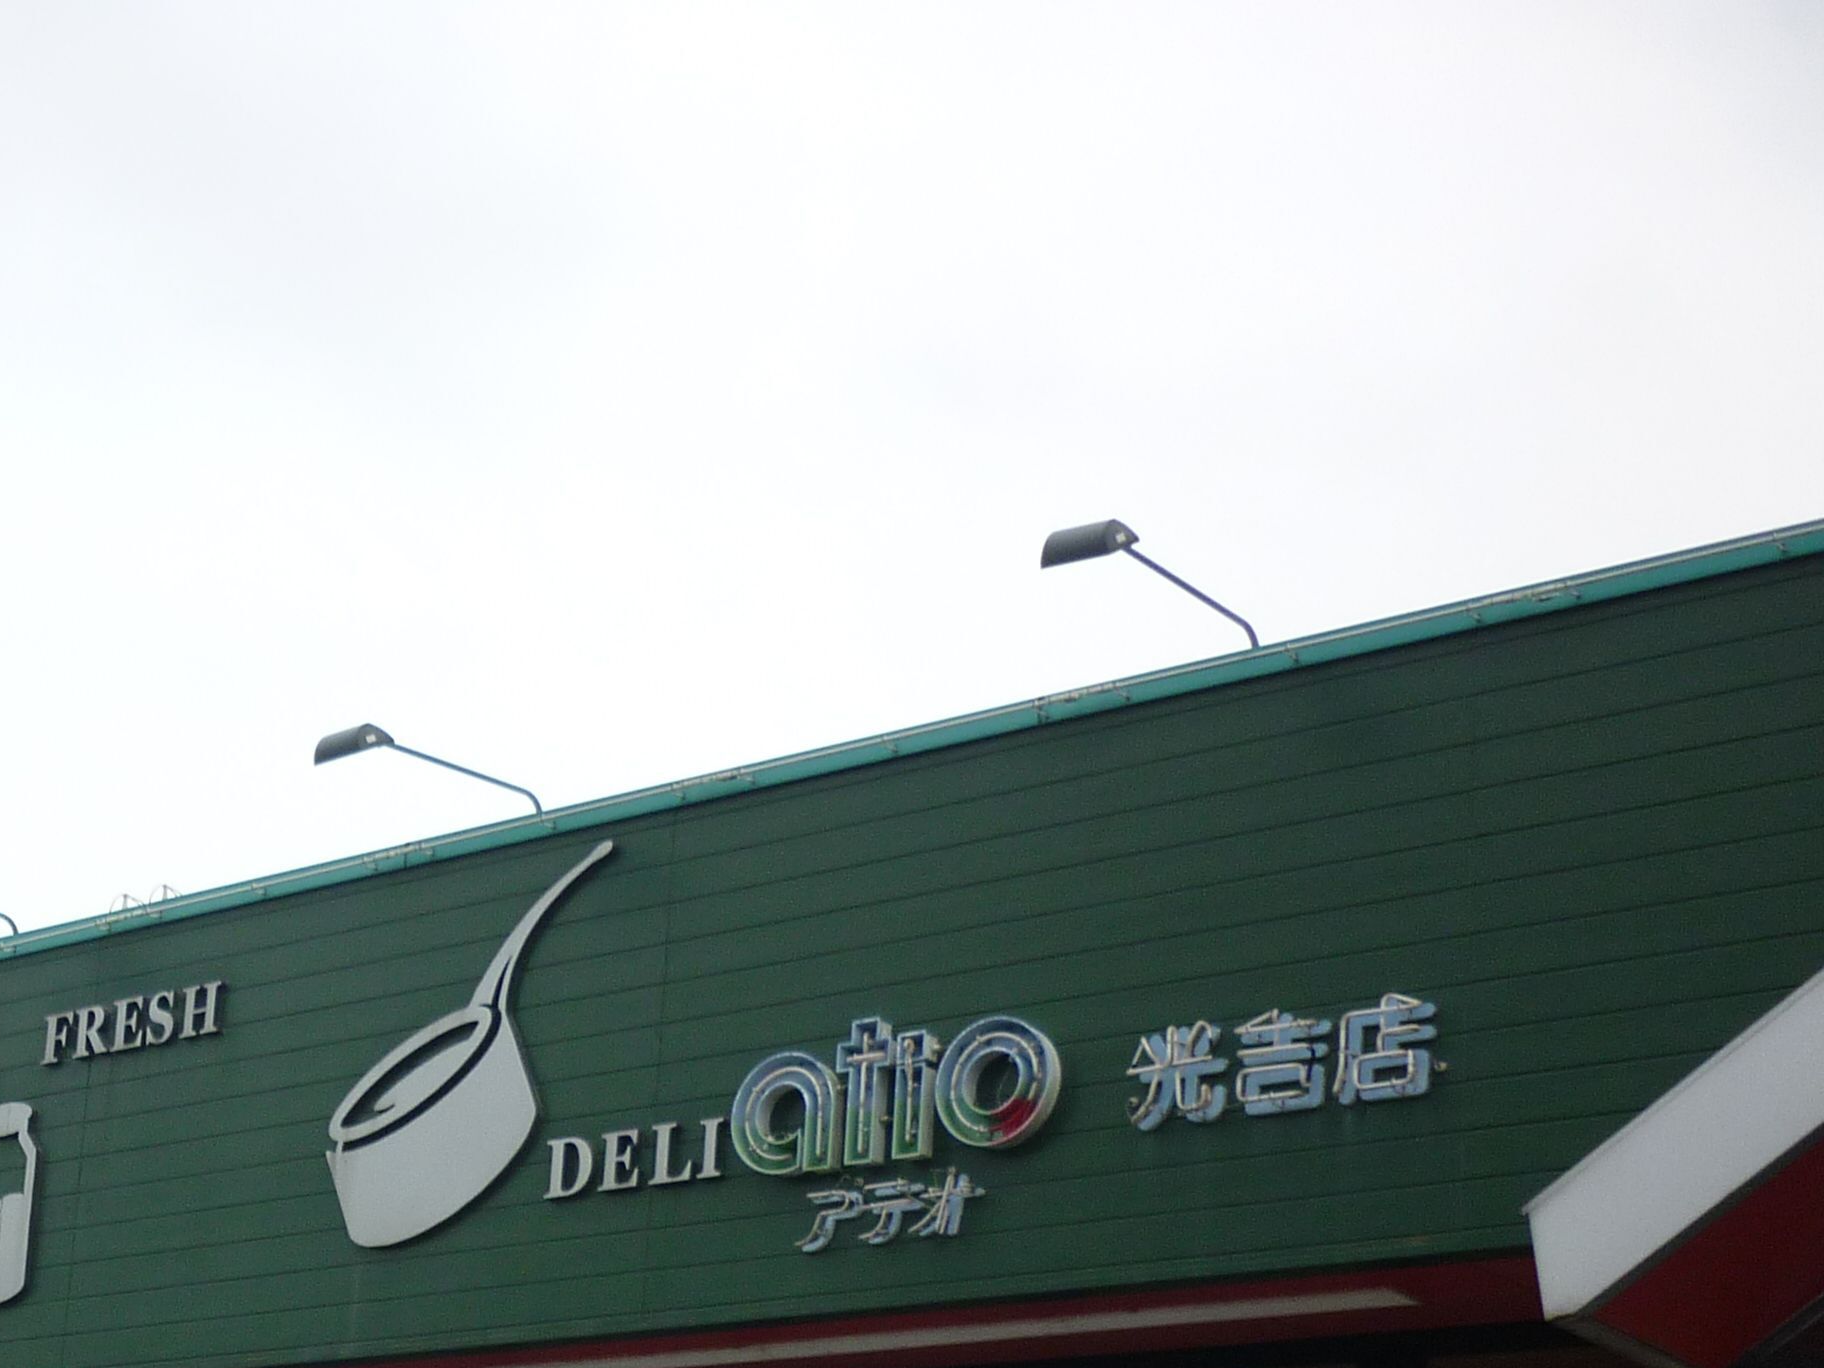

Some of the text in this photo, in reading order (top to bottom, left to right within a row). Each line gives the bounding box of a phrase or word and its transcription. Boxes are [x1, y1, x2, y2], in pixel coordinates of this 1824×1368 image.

[40, 980, 224, 1067] FRESH
[1126, 992, 1438, 1132] 光吉店
[730, 1015, 1061, 1176] atio
[543, 1116, 725, 1201] DELI
[794, 1167, 986, 1252] アテオ
